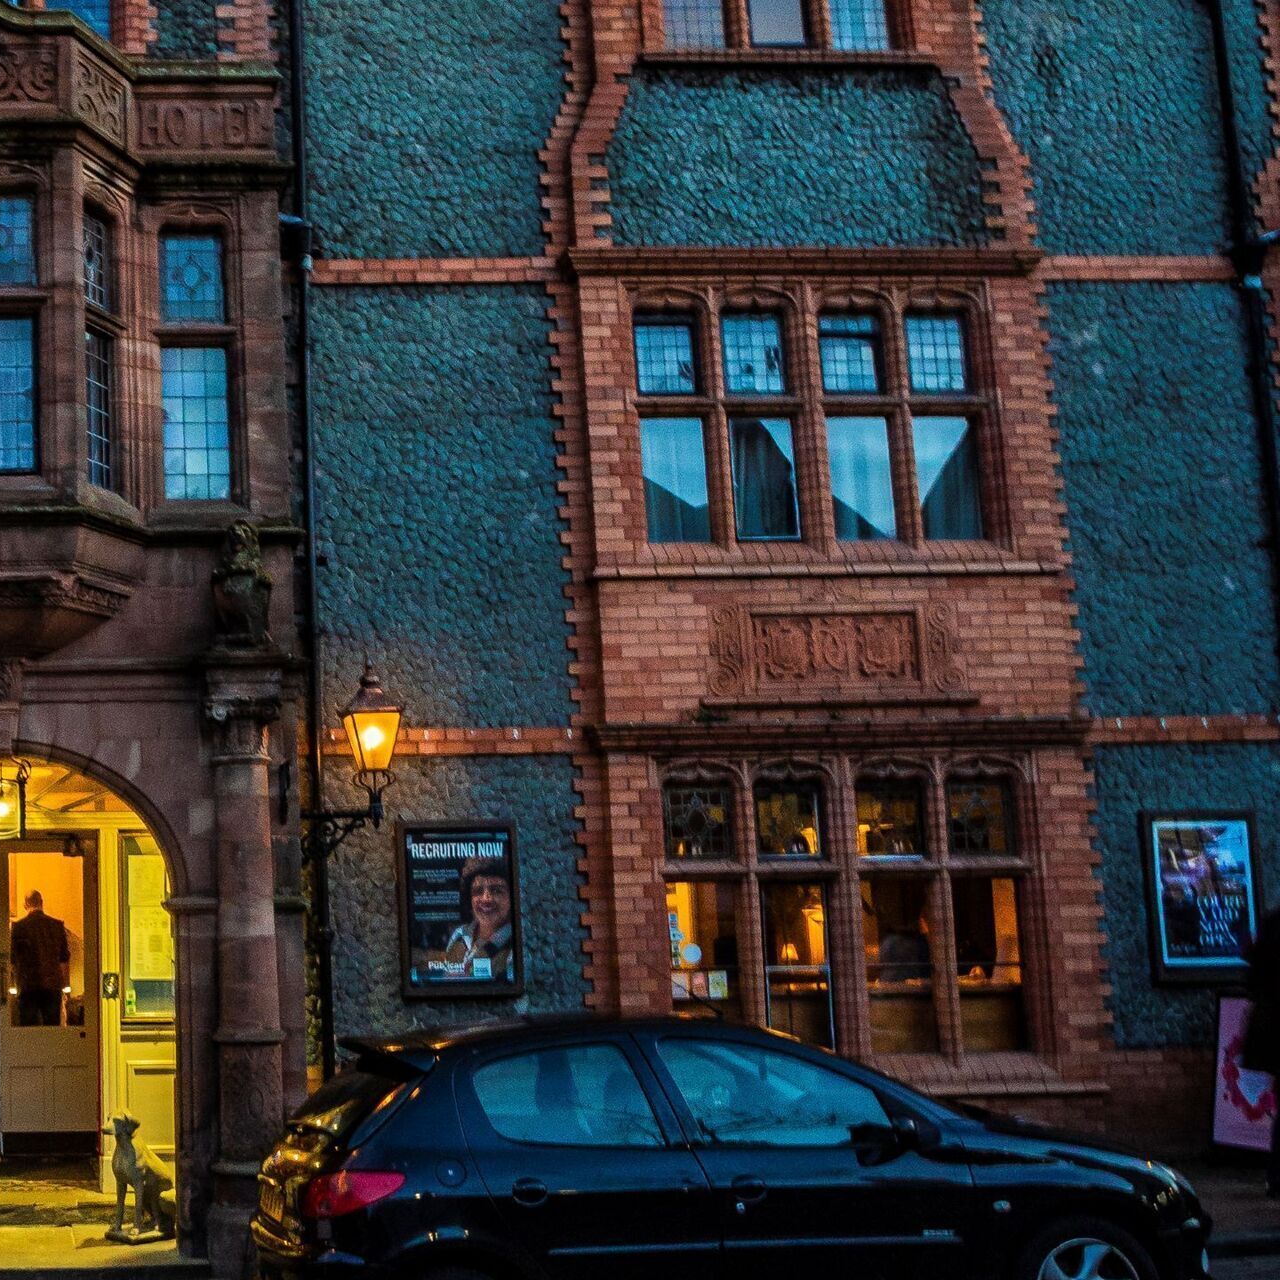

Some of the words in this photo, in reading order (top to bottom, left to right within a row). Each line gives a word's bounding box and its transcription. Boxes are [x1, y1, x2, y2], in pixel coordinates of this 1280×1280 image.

[137, 102, 271, 149] HOTEL
[411, 842, 476, 859] RECRUITING
[478, 842, 503, 857] NOW
